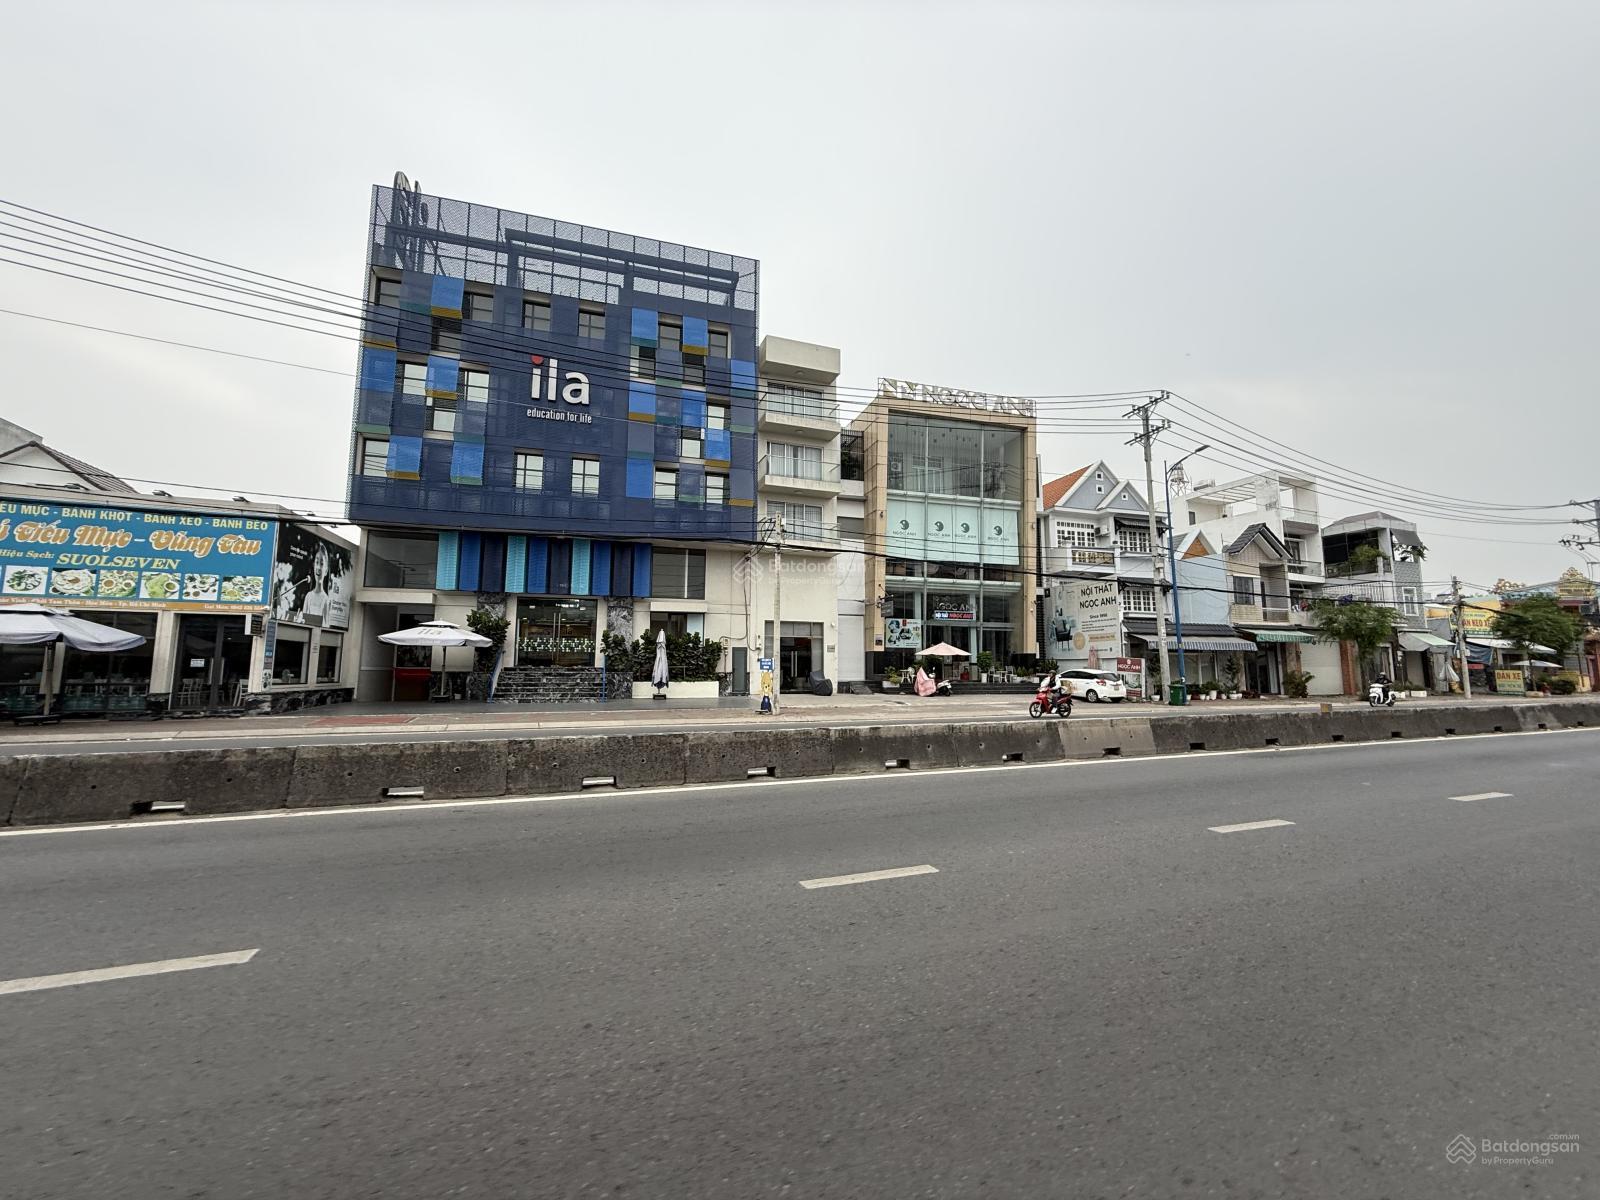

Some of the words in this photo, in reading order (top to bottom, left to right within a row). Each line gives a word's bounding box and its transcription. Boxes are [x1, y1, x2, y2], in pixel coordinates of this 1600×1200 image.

[530, 354, 590, 405] ila
[526, 408, 565, 420] education
[567, 412, 578, 422] for
[580, 413, 592, 424] life
[56, 553, 181, 570] SUOLSEVEN
[1100, 596, 1116, 606] ANH
